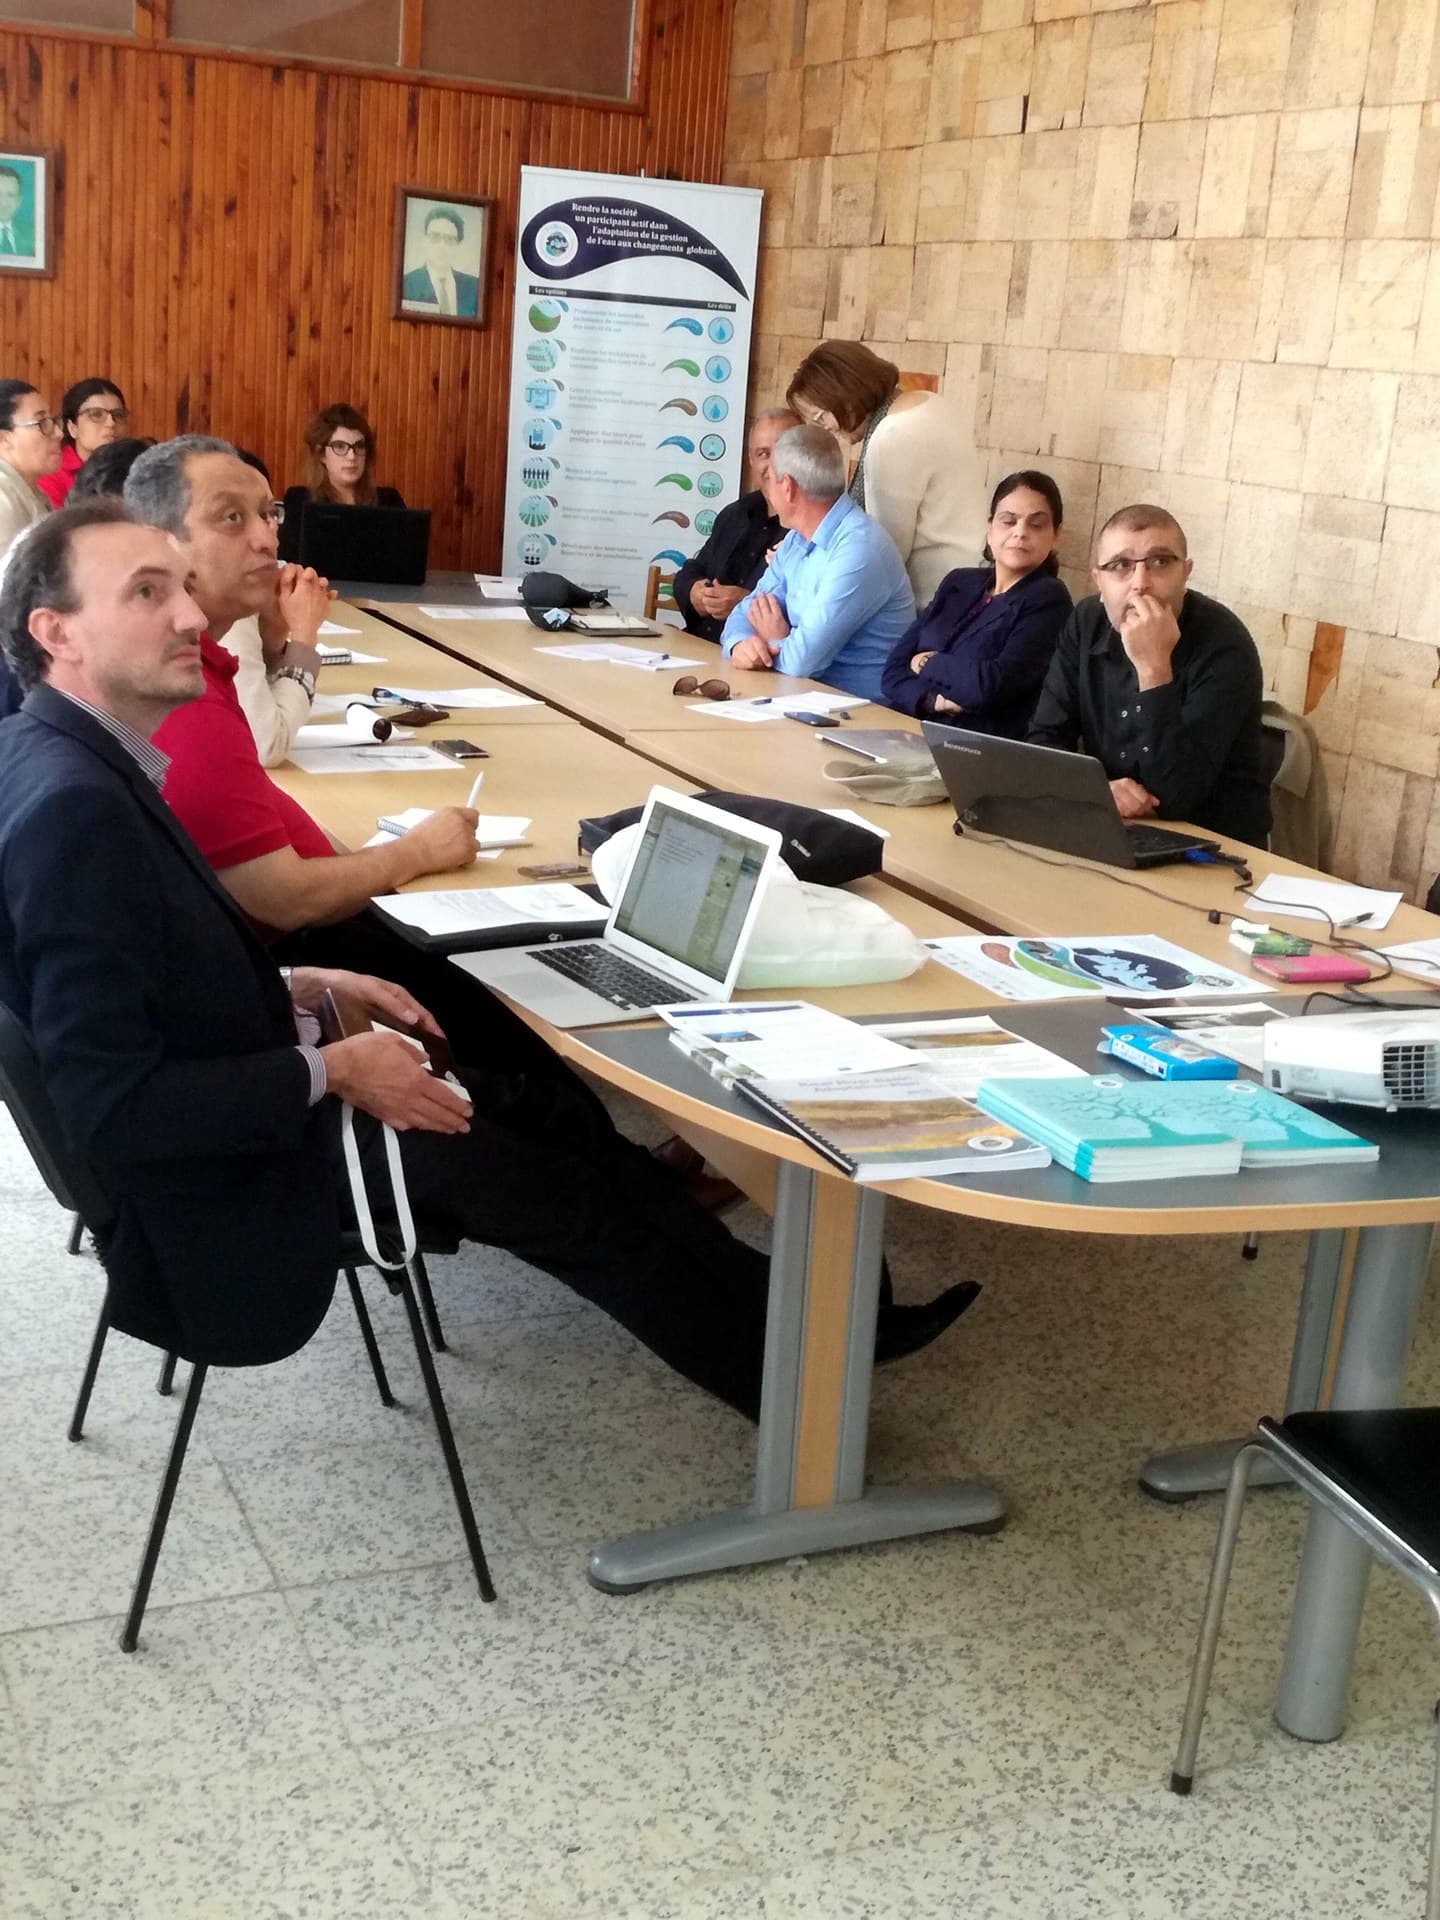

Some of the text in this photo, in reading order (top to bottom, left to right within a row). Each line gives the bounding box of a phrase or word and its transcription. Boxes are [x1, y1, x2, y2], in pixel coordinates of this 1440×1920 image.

[572, 203, 638, 217] Rendre la société
[575, 214, 669, 230] un participant actif dans
[592, 226, 689, 243] l'adaptation de la gestion
[586, 236, 718, 256] de l'eau aux changements globaux
[944, 740, 982, 756] lenovo
